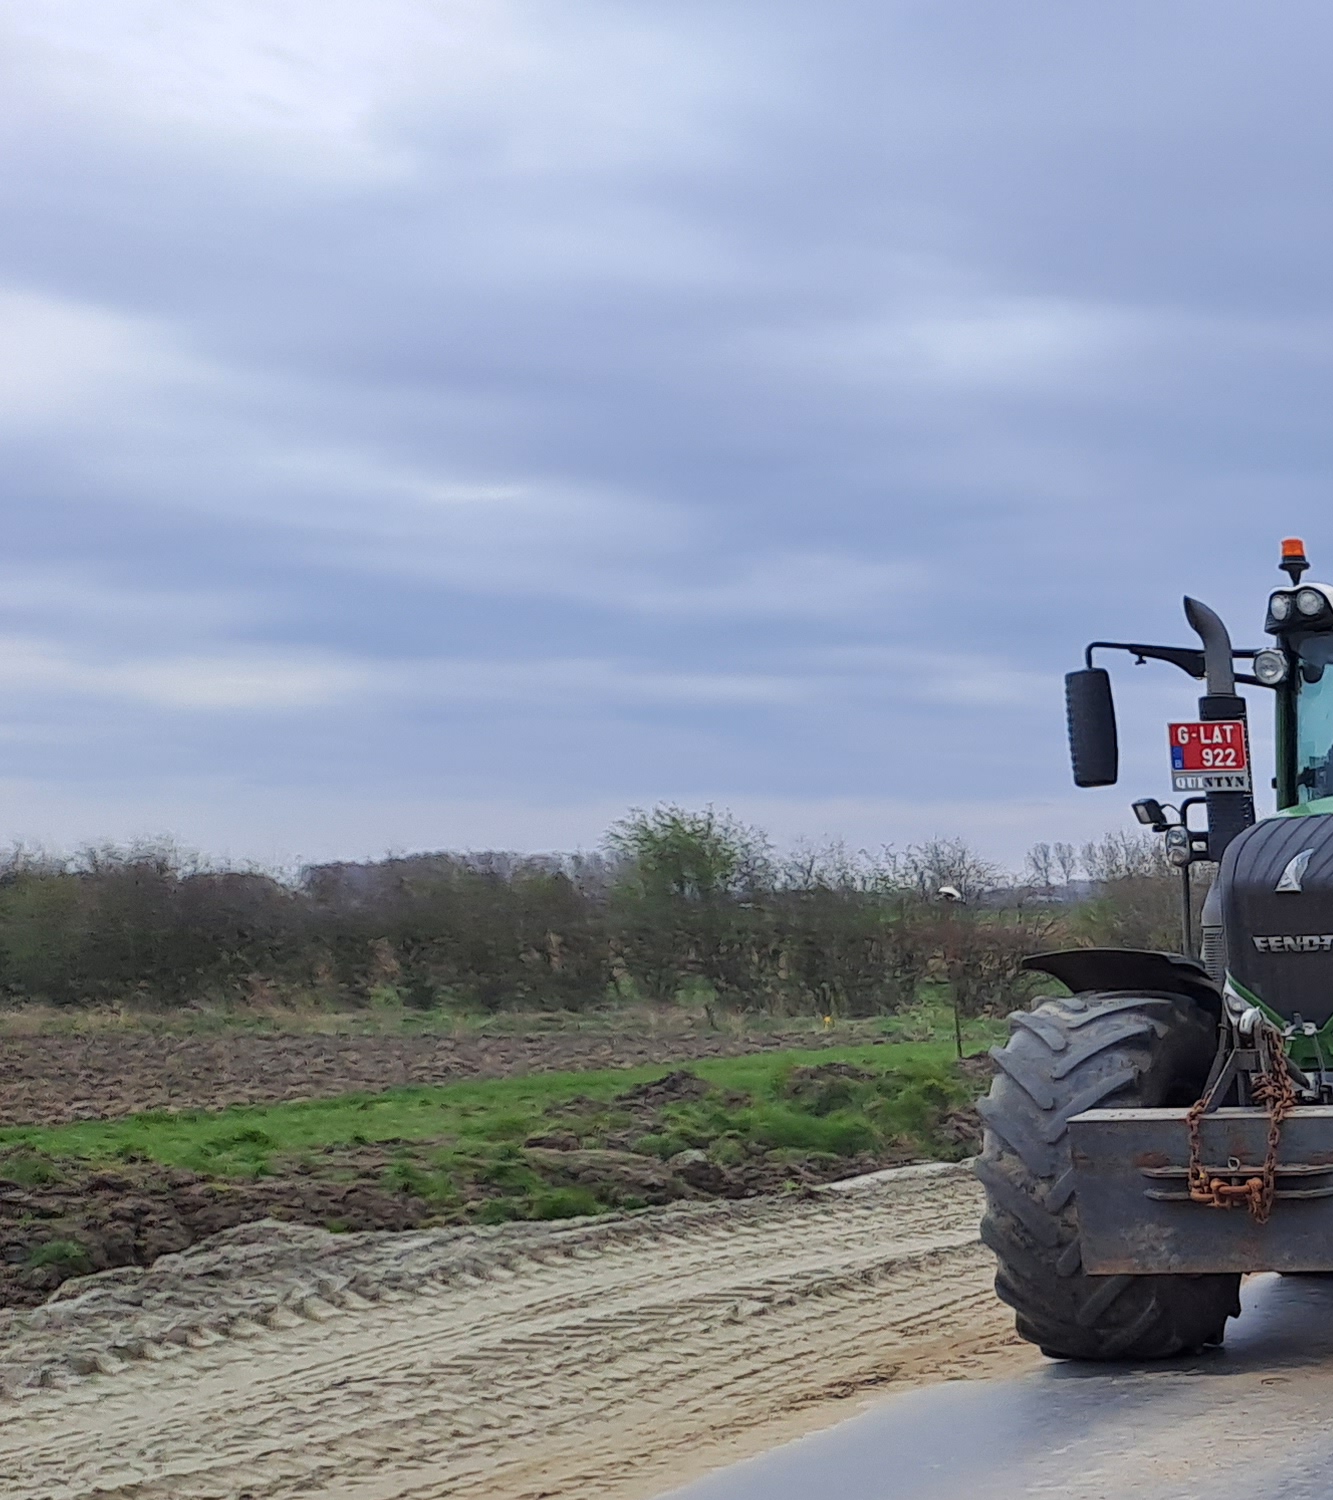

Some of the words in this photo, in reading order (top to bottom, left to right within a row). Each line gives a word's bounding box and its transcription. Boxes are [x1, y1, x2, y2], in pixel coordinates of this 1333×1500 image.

[1177, 725, 1234, 744] G-LAT
[1202, 748, 1237, 767] 922
[1175, 776, 1245, 789] QUINTYN
